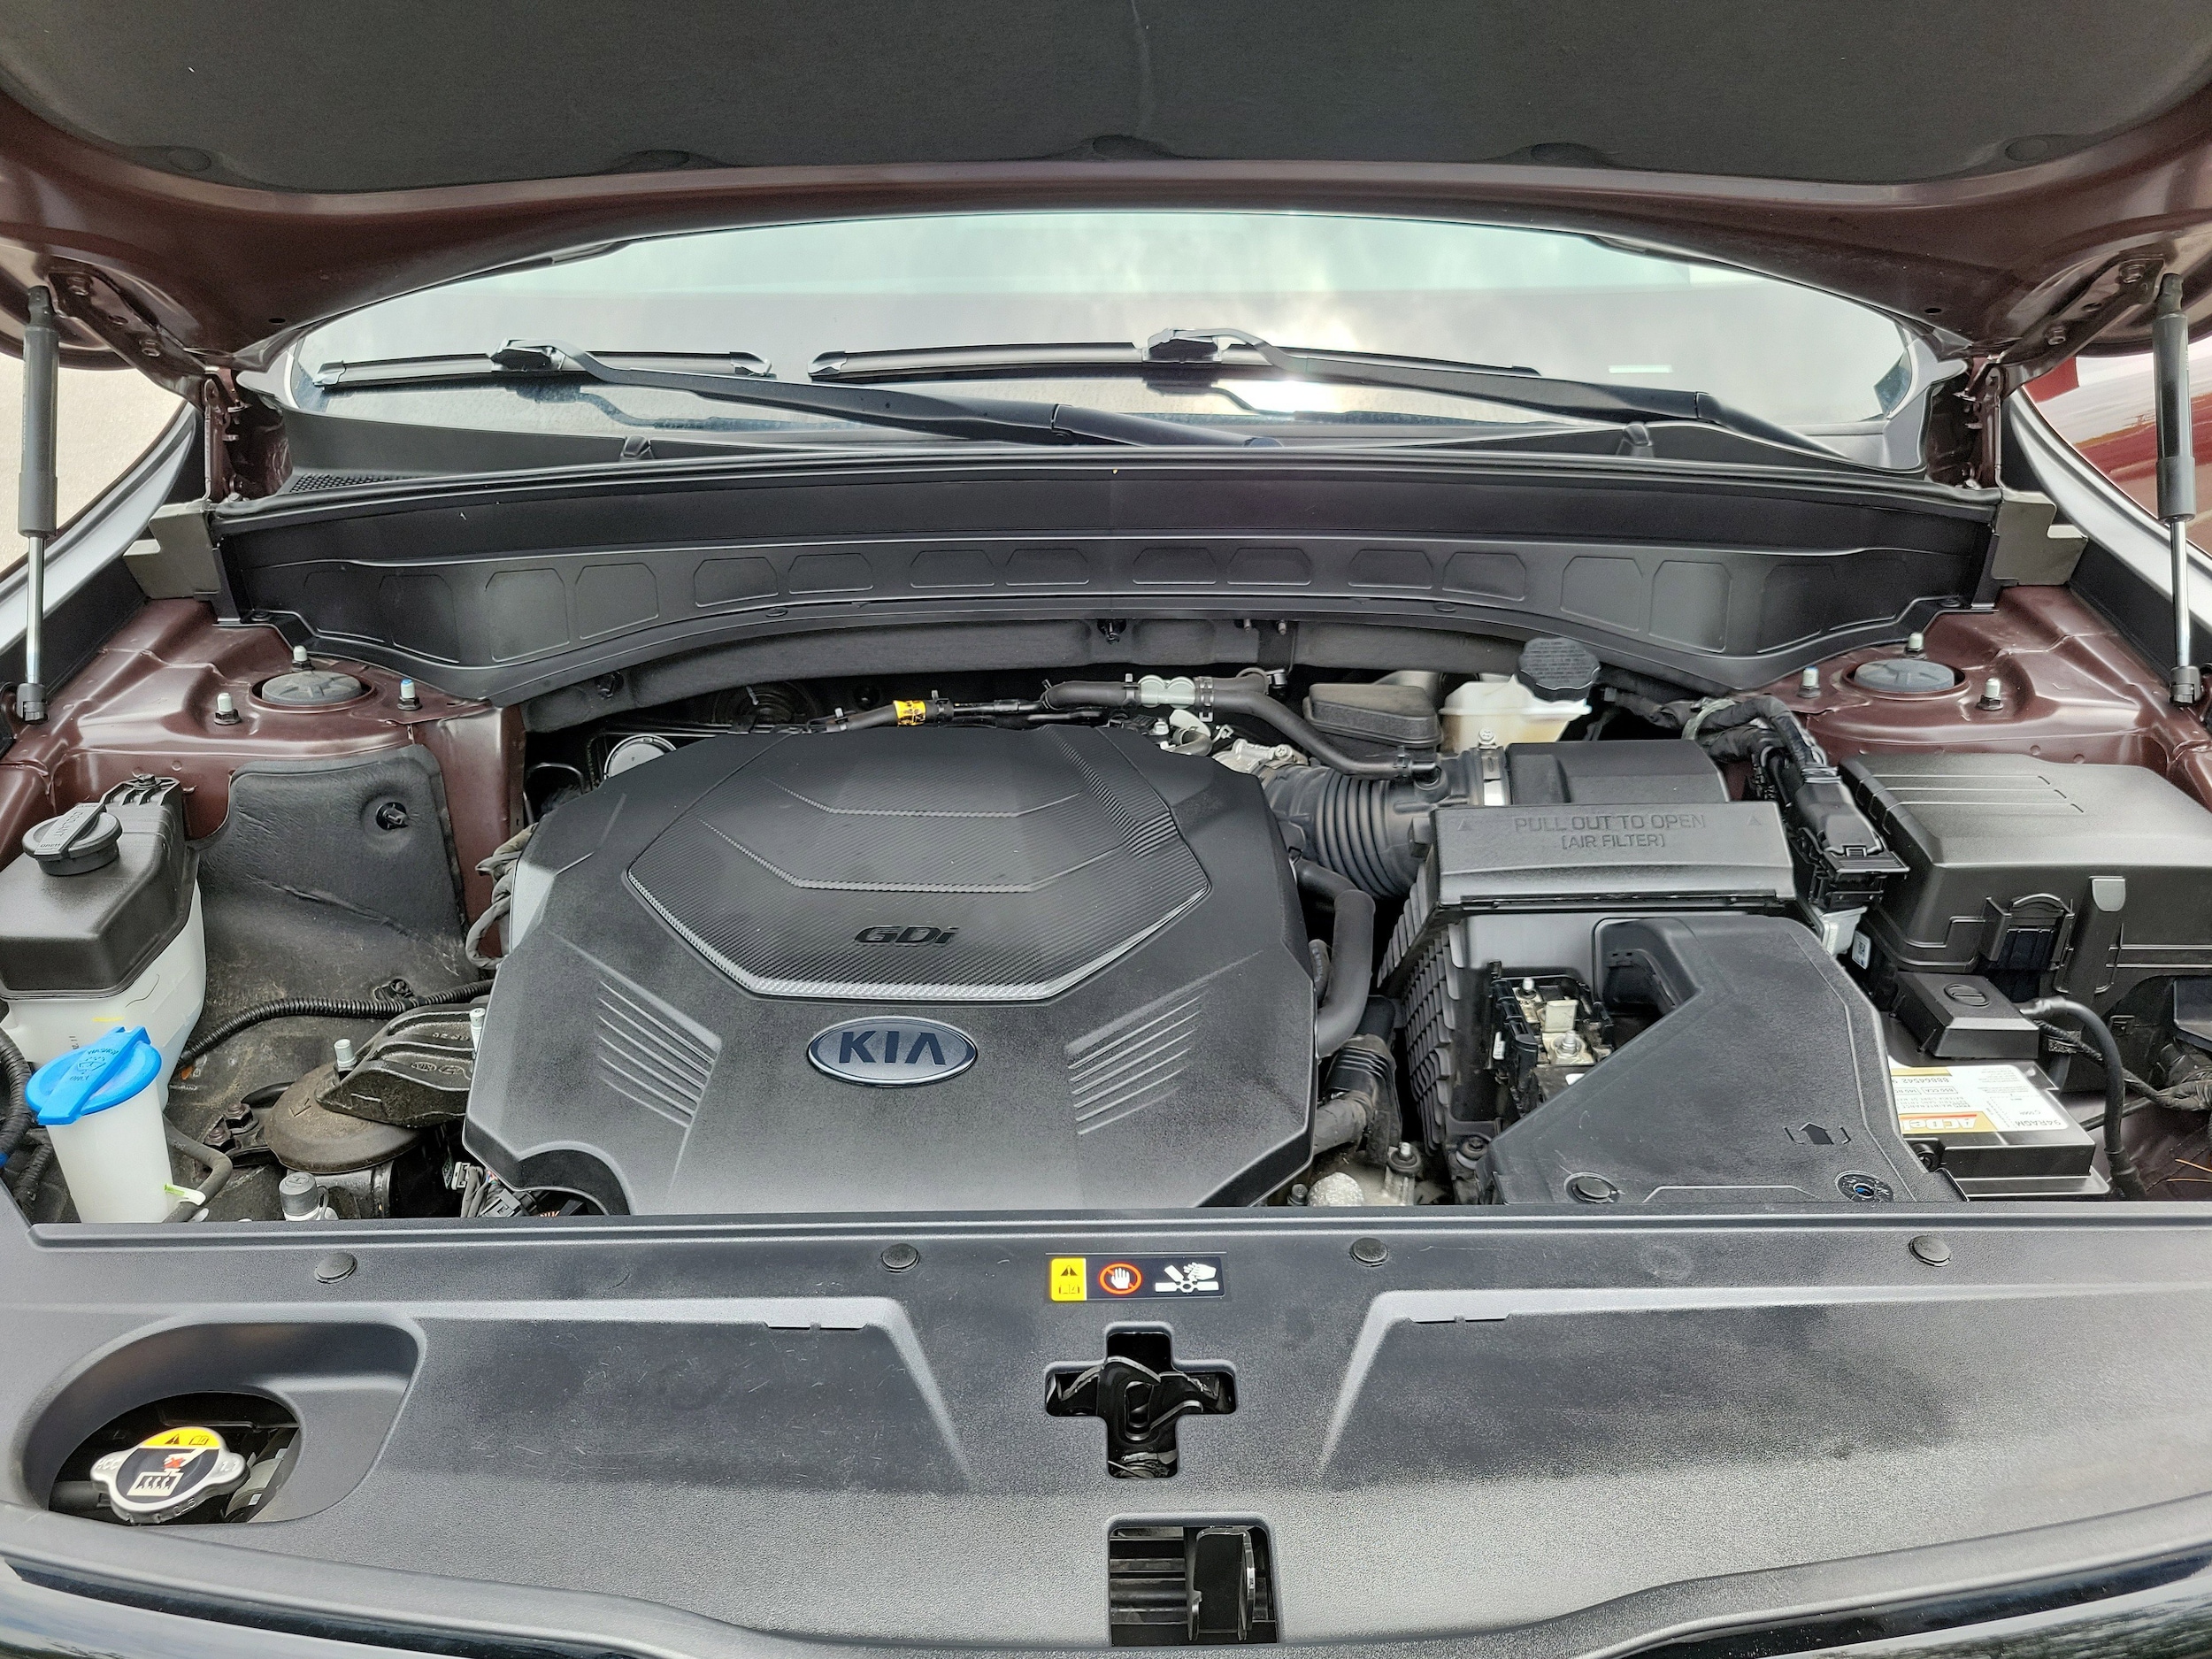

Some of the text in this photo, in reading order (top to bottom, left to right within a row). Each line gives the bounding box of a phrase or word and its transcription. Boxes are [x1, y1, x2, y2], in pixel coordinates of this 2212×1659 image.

[1514, 813, 1706, 832] PULL OUT TO OPEN
[854, 926, 959, 947] GDi
[839, 1030, 947, 1065] KIA
[1901, 1118, 1976, 1131] ACDel
